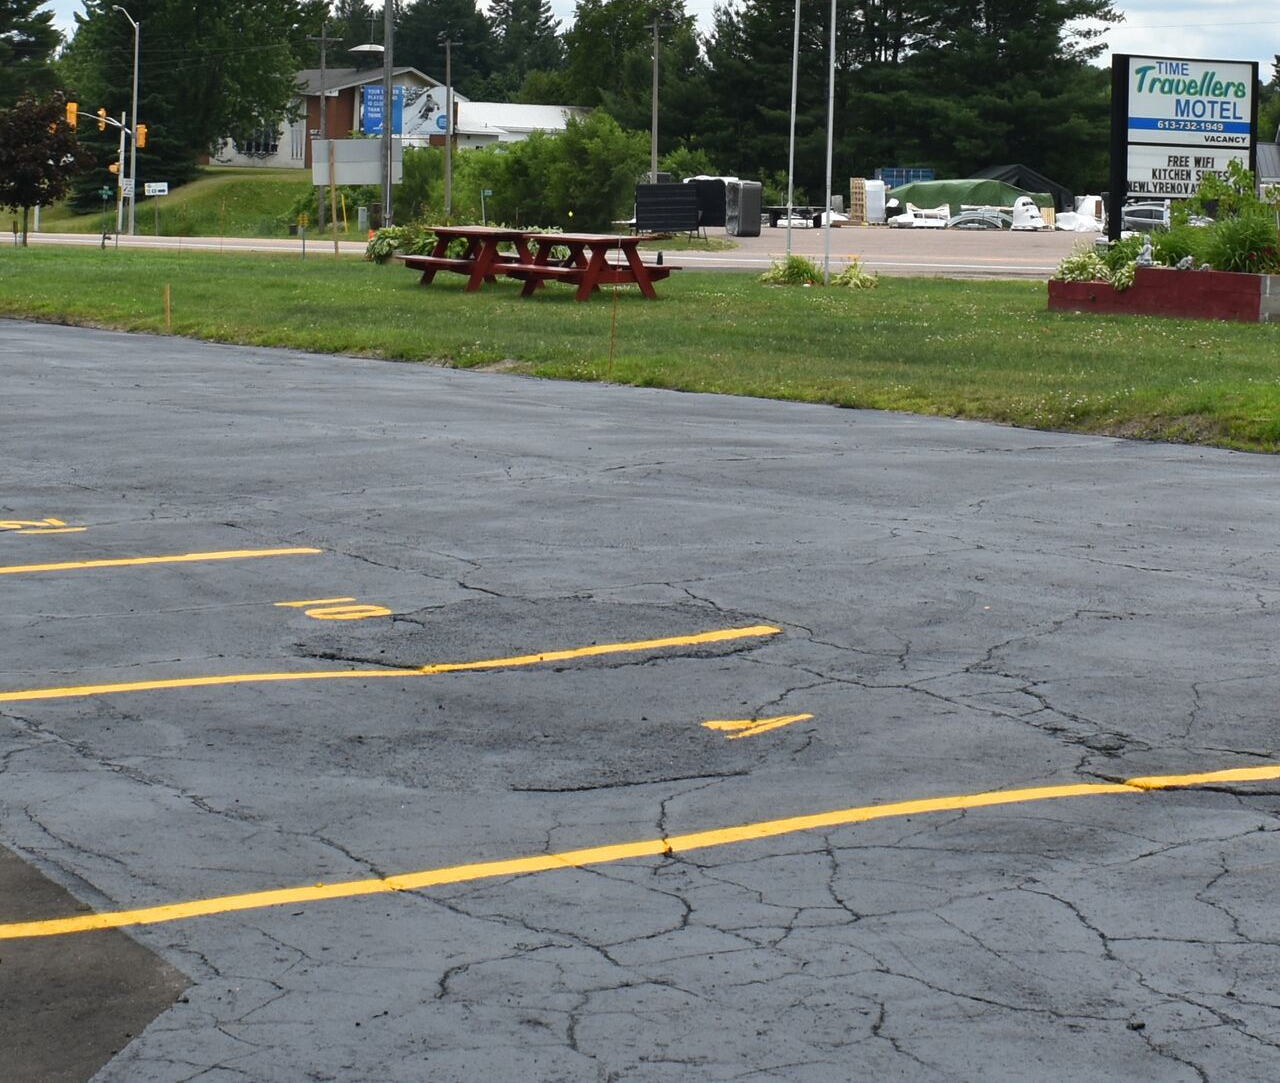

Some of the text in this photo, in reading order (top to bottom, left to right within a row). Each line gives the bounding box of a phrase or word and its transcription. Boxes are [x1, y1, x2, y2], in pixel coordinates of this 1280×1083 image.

[1156, 61, 1190, 76] TIME
[1135, 65, 1247, 98] Travellers
[1175, 99, 1243, 120] MOTEL
[1157, 120, 1224, 131] 613-732-1949
[1204, 135, 1247, 144] VACANCY
[1167, 155, 1215, 168] FREE WIFI
[1151, 168, 1191, 181] KITCHEN
